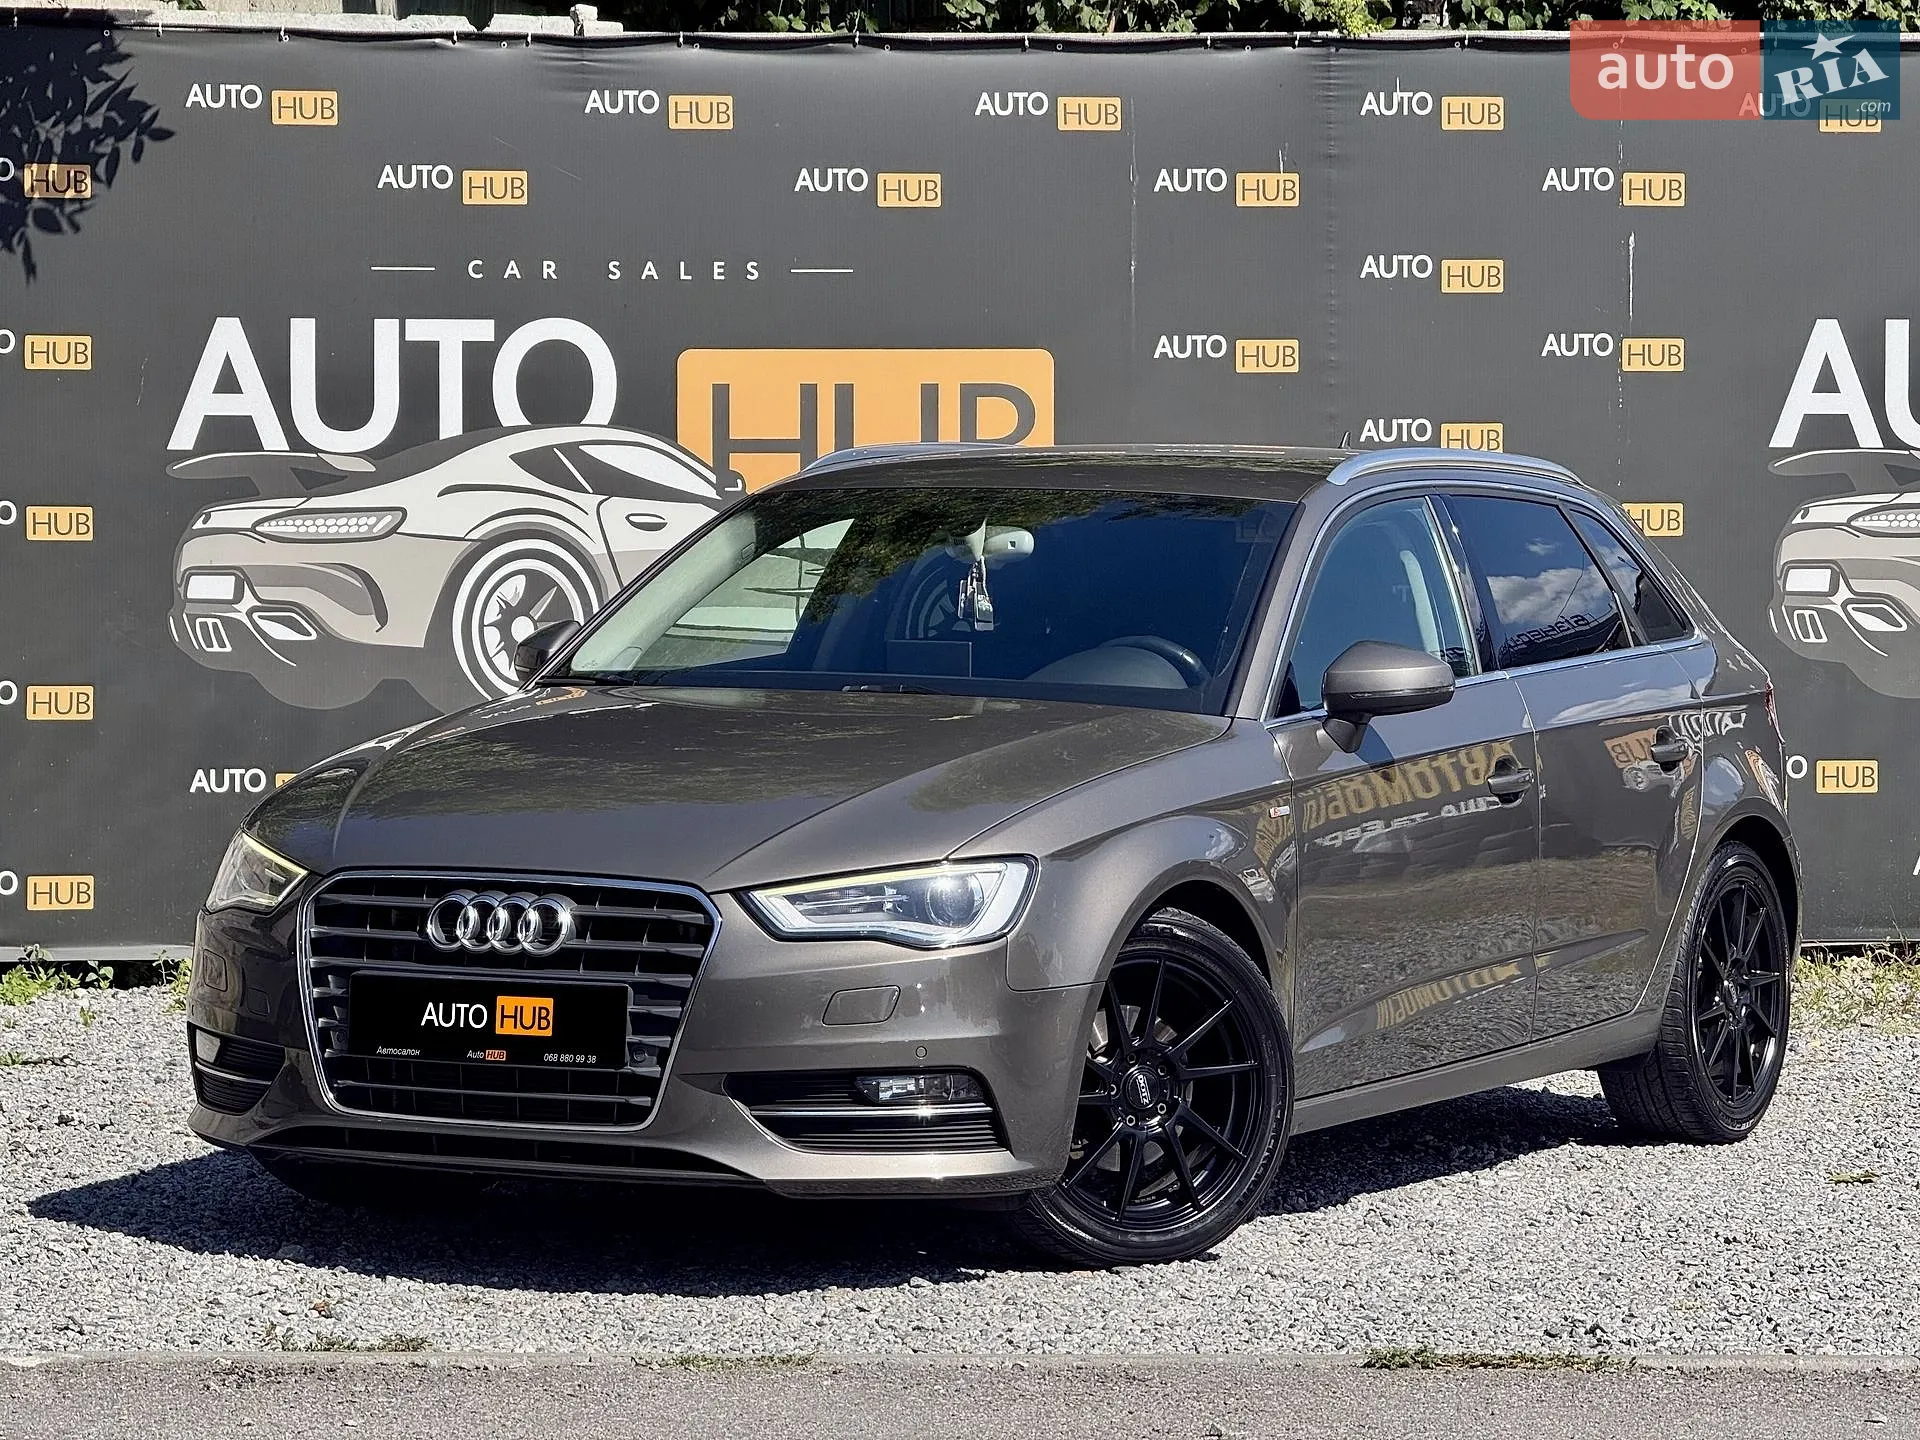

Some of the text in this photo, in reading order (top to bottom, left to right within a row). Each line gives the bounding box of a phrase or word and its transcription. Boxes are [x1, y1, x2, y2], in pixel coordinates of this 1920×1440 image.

[185, 83, 333, 120] AUTO HUB
[584, 89, 730, 124] AUTO HUB
[974, 91, 1118, 125] AUTO HUB
[1359, 91, 1501, 125] AUTO HUB
[30, 168, 88, 193] HUB
[377, 164, 525, 200] AUTO HUB
[793, 167, 938, 202] AUTO HUB
[1153, 167, 1296, 202] AUTO HUB
[1541, 166, 1681, 202] AUTO HUB
[467, 259, 760, 281] CAR SALES
[1359, 254, 1501, 288] AUTO HUB
[30, 341, 89, 365] HUB
[1153, 334, 1296, 368] AUTO HUB
[1540, 332, 1681, 367] AUTO HUB
[166, 317, 617, 453] AUTO
[1359, 418, 1501, 450] AUTO HUB
[32, 513, 90, 536] HUB
[33, 691, 91, 715] HUB
[189, 767, 267, 794] AUTO
[1823, 766, 1874, 788] HUB
[33, 882, 91, 905] HUB
[421, 1001, 551, 1031] AUTO HUB
[376, 1045, 421, 1056] Автосалон
[466, 1049, 506, 1060] Auto HUB
[575, 1054, 585, 1064] 99
[1137, 1074, 1150, 1106] DOTZ
